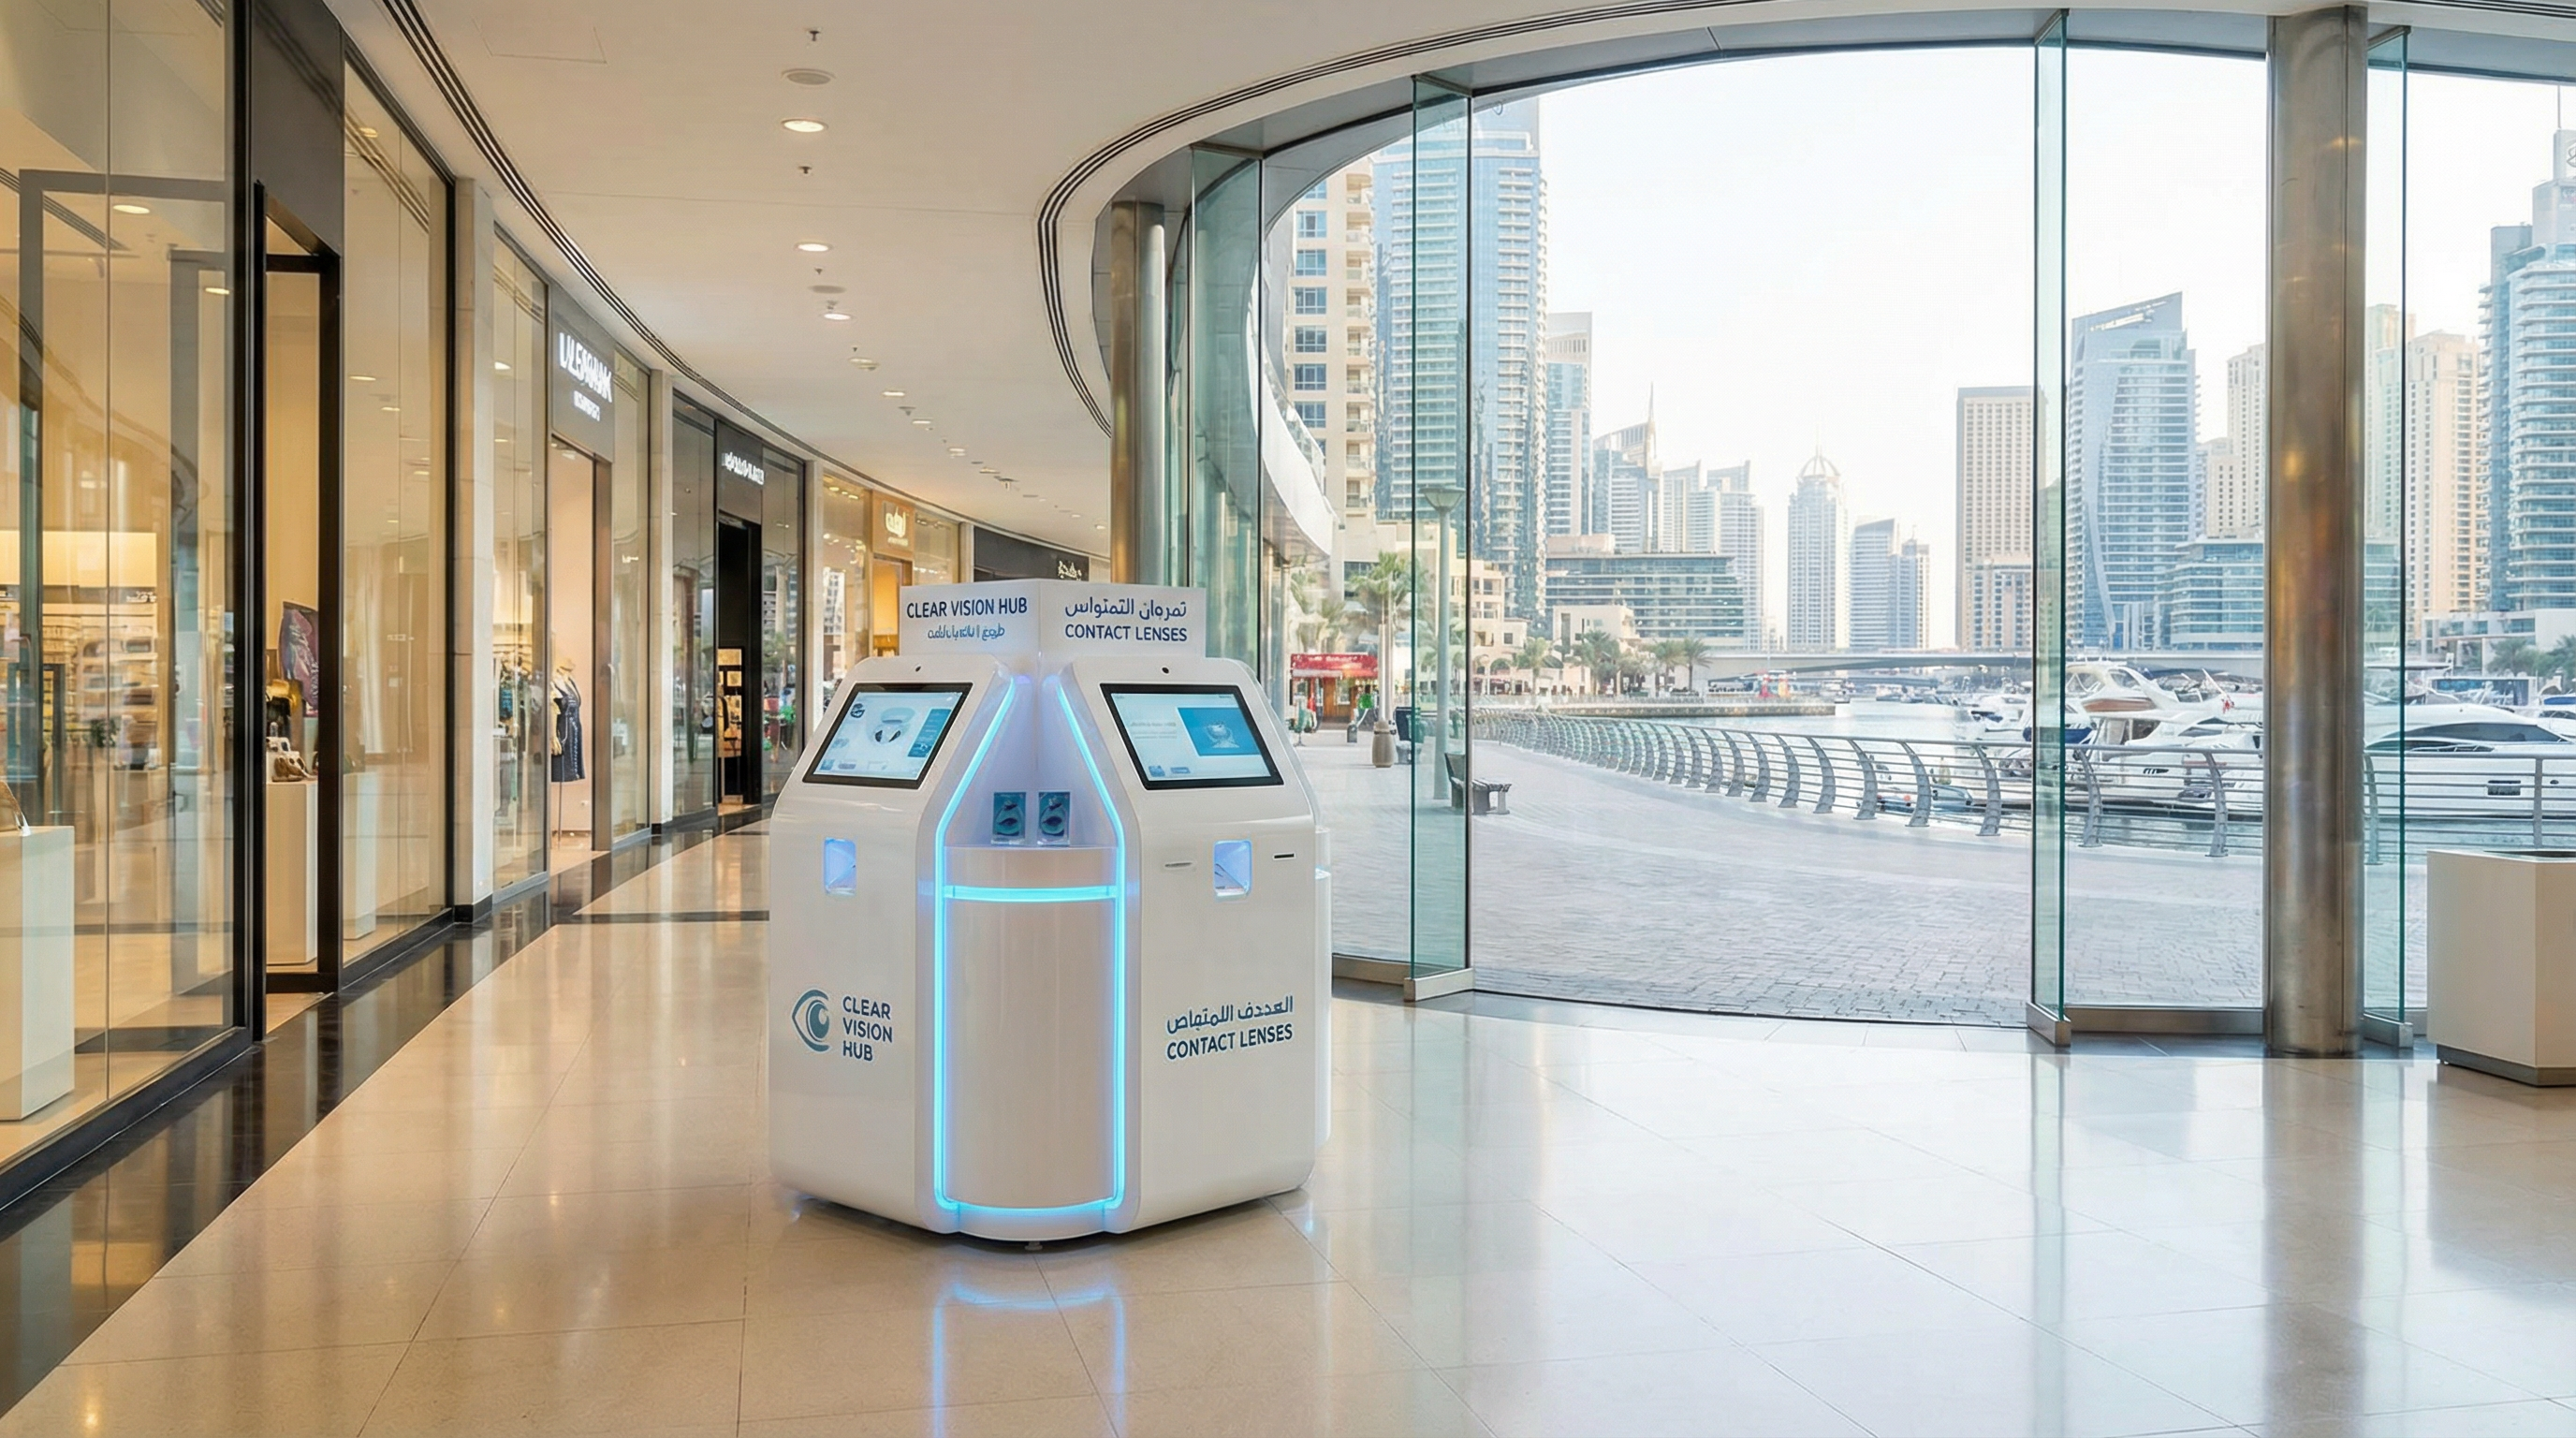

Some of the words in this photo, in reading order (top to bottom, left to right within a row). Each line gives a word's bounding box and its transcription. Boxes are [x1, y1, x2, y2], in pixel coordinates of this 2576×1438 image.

[906, 601, 947, 618] CLEAR
[951, 598, 995, 617] VISION
[999, 597, 1028, 614] HUB
[1064, 624, 1132, 640] CONTACT
[1135, 626, 1188, 642] LENSES
[842, 995, 891, 1020] CLEAR
[842, 1017, 893, 1043] VISION
[1166, 1032, 1236, 1061] CONTACT
[1239, 1023, 1294, 1049] LENSES
[842, 1040, 873, 1063] HUB
